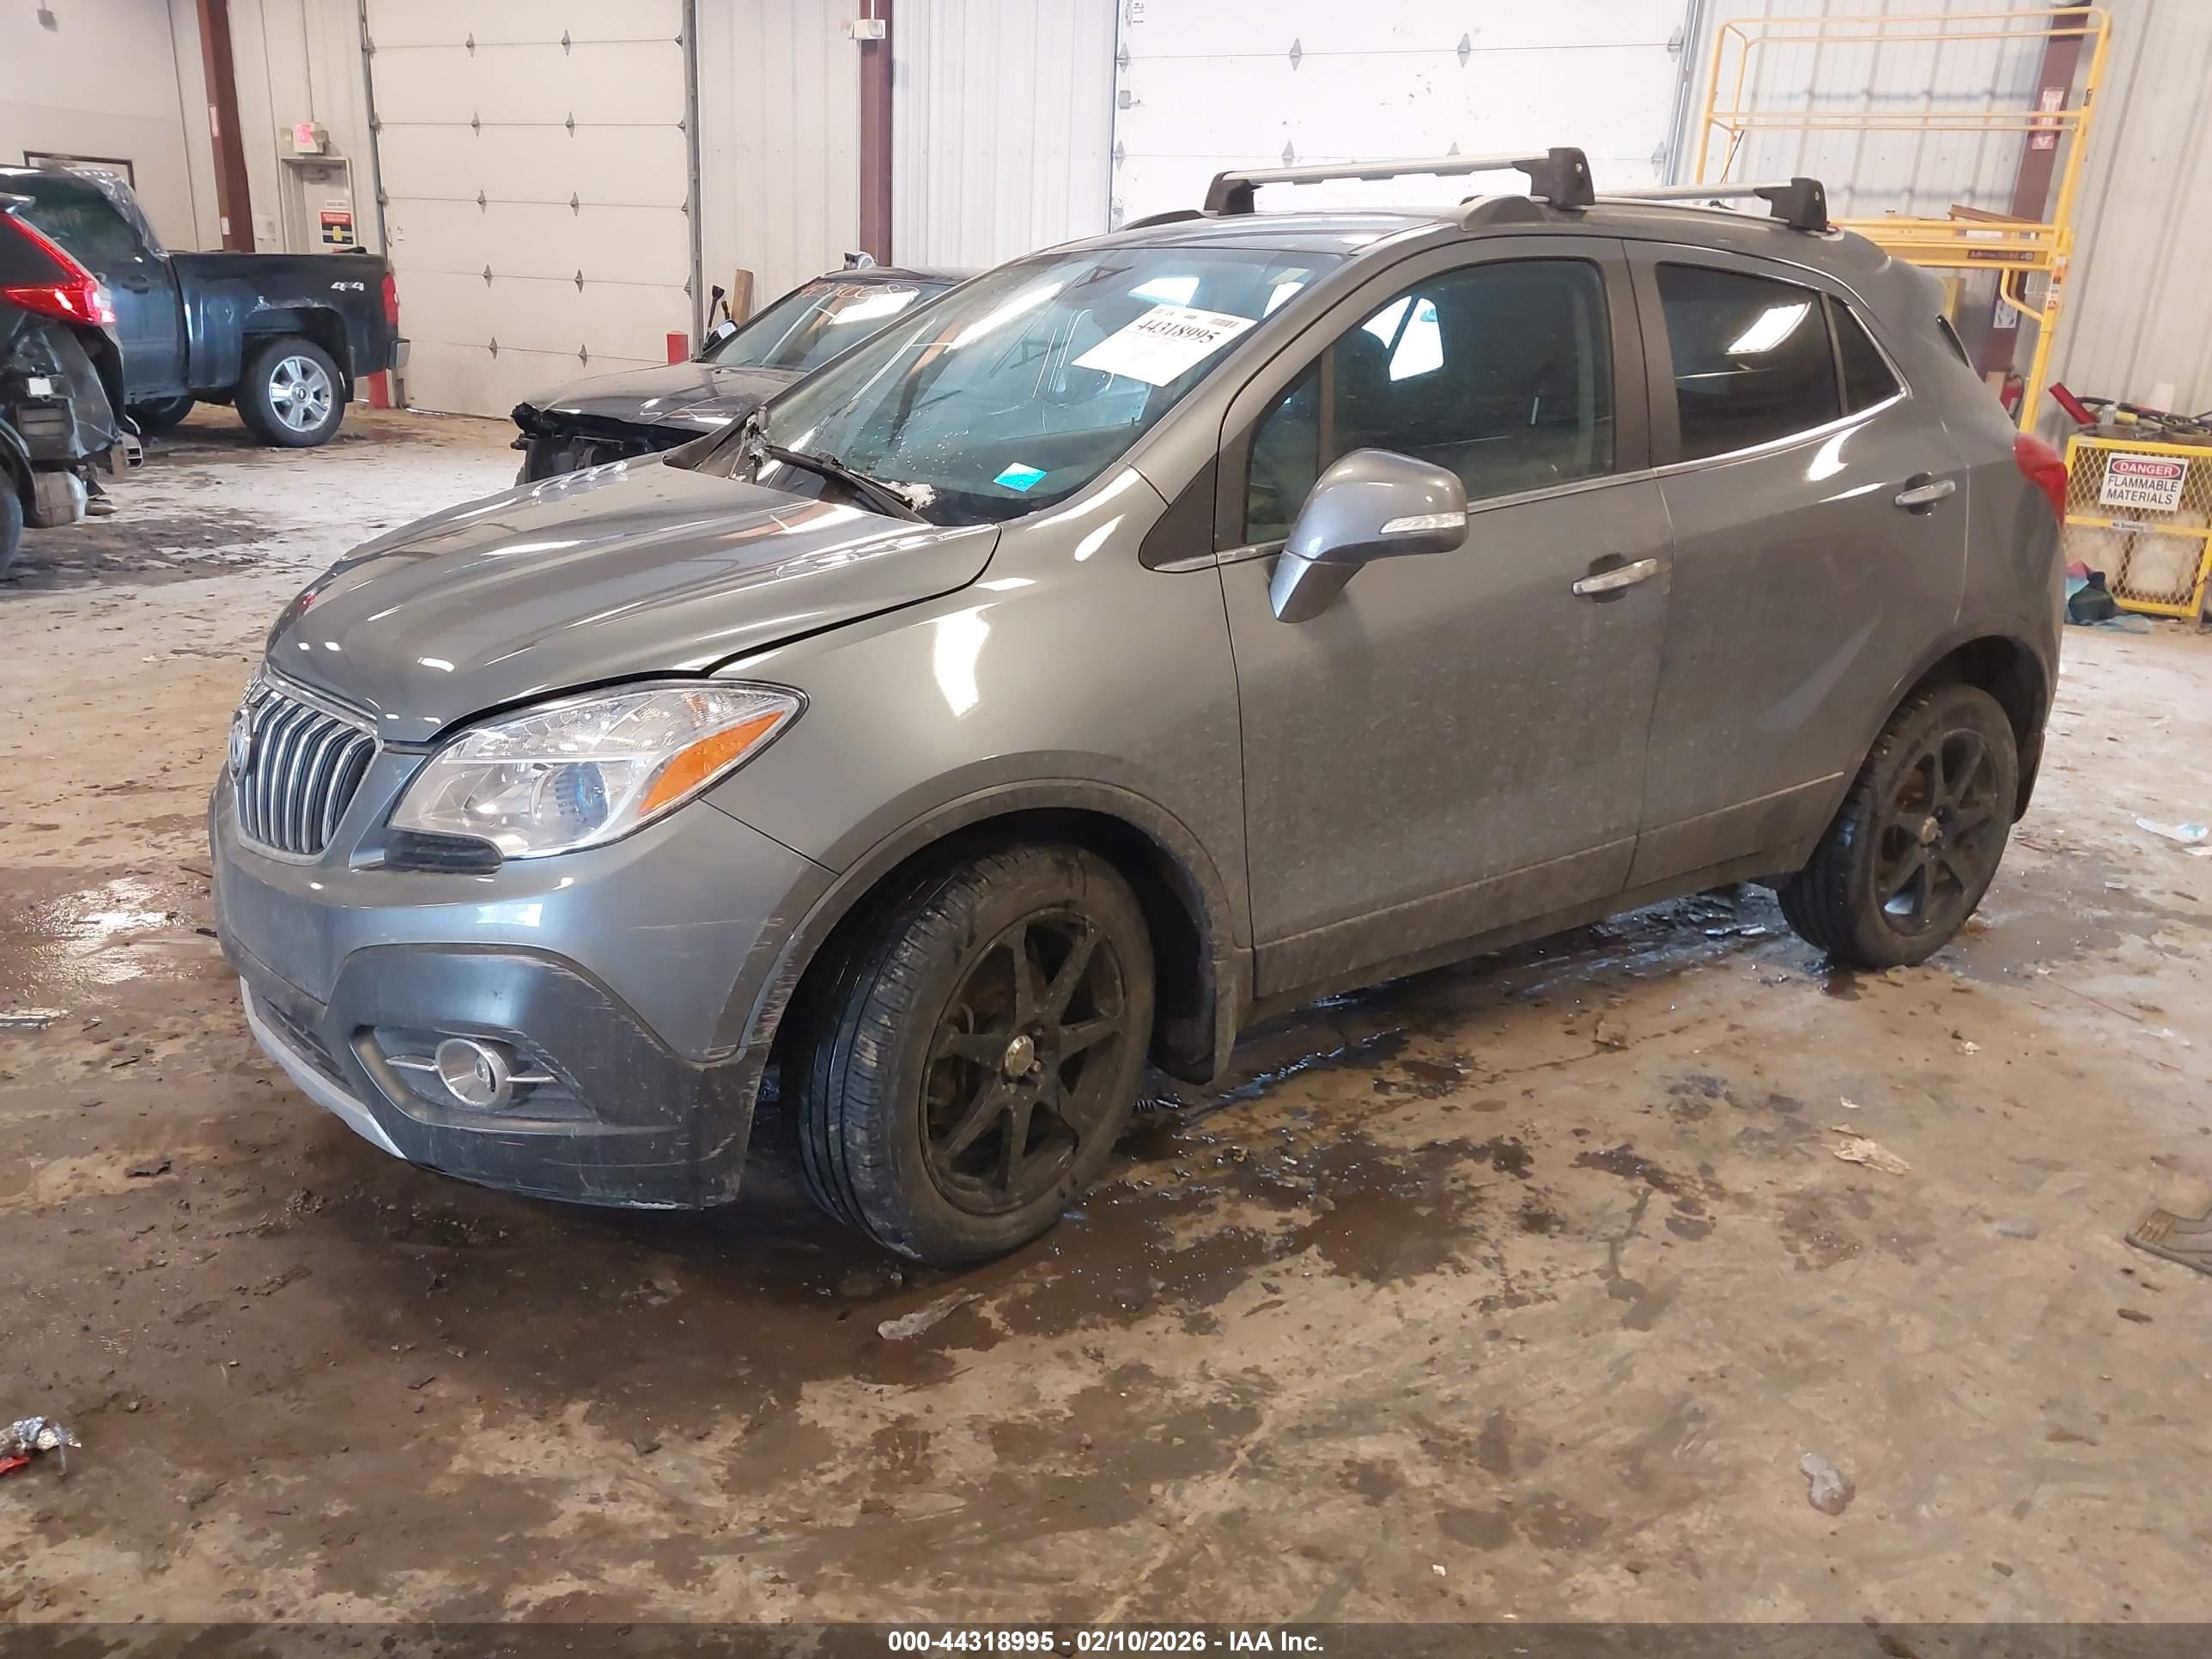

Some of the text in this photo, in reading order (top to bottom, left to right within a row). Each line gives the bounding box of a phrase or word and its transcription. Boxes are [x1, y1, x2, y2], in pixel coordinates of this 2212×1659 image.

[1138, 319, 1221, 343] 44318995
[2119, 462, 2173, 477] DANGER
[2107, 476, 2179, 493] FLAMMABLE
[2106, 489, 2173, 505] MATERIALS
